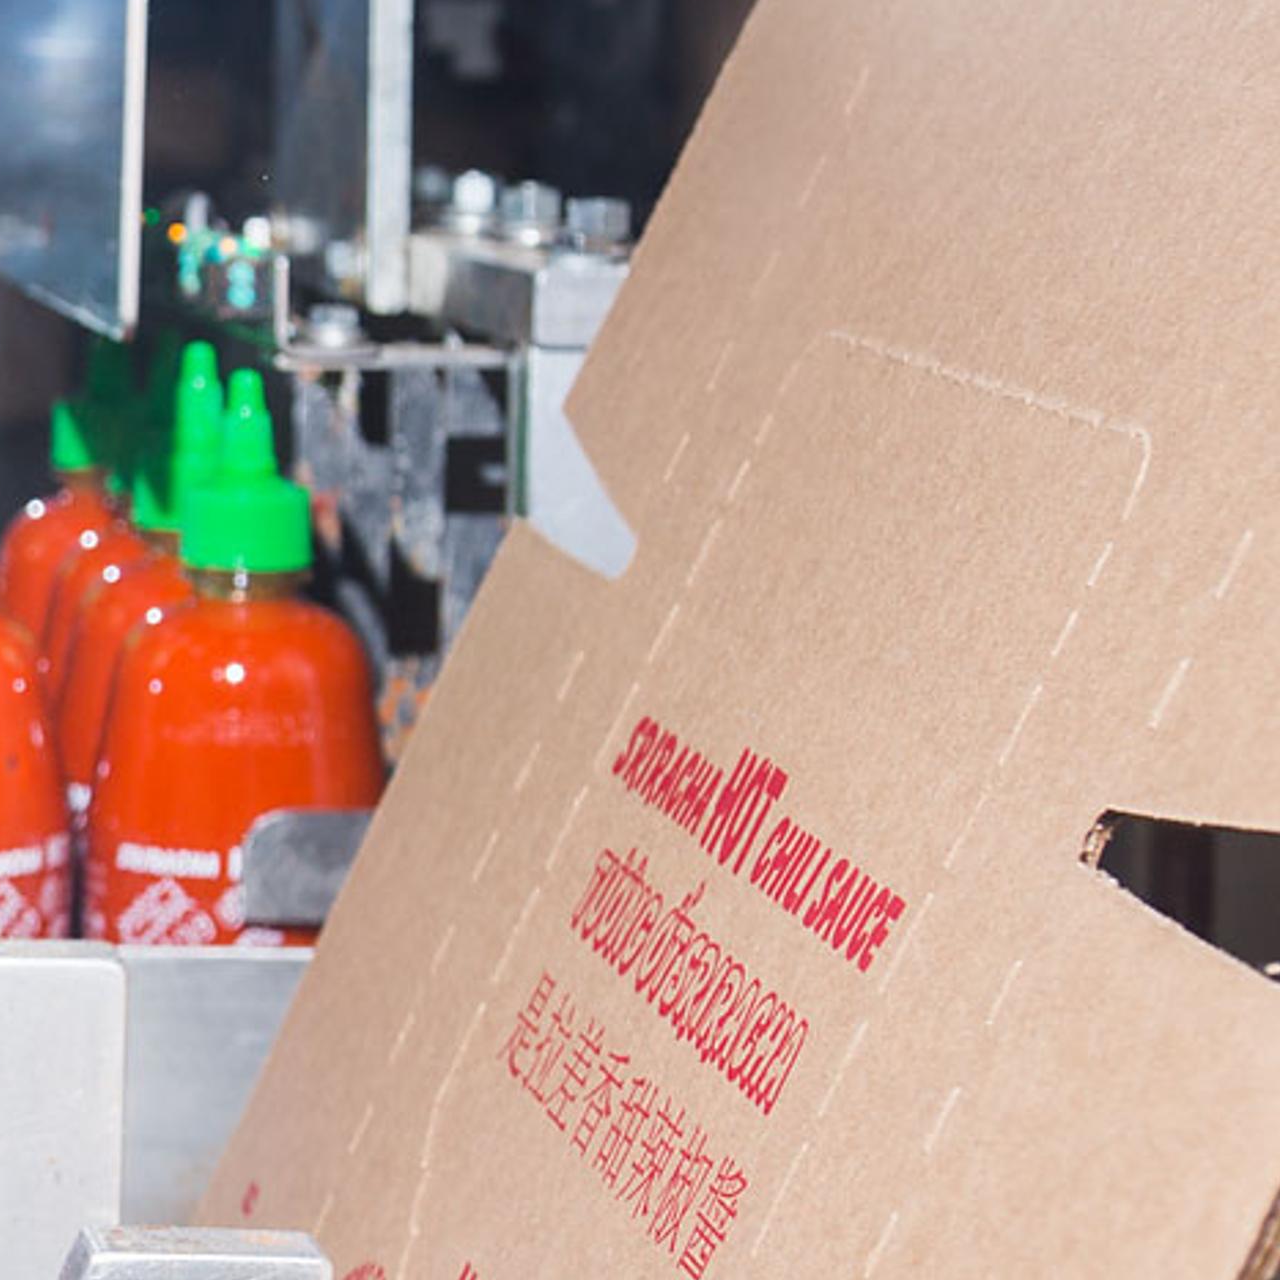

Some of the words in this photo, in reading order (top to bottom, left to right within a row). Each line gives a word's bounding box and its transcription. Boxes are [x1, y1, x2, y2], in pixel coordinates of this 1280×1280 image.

[612, 716, 723, 835] SRIRACHA
[700, 746, 788, 875] HOT
[750, 816, 832, 915] CHILI
[803, 858, 906, 972] SAUCE
